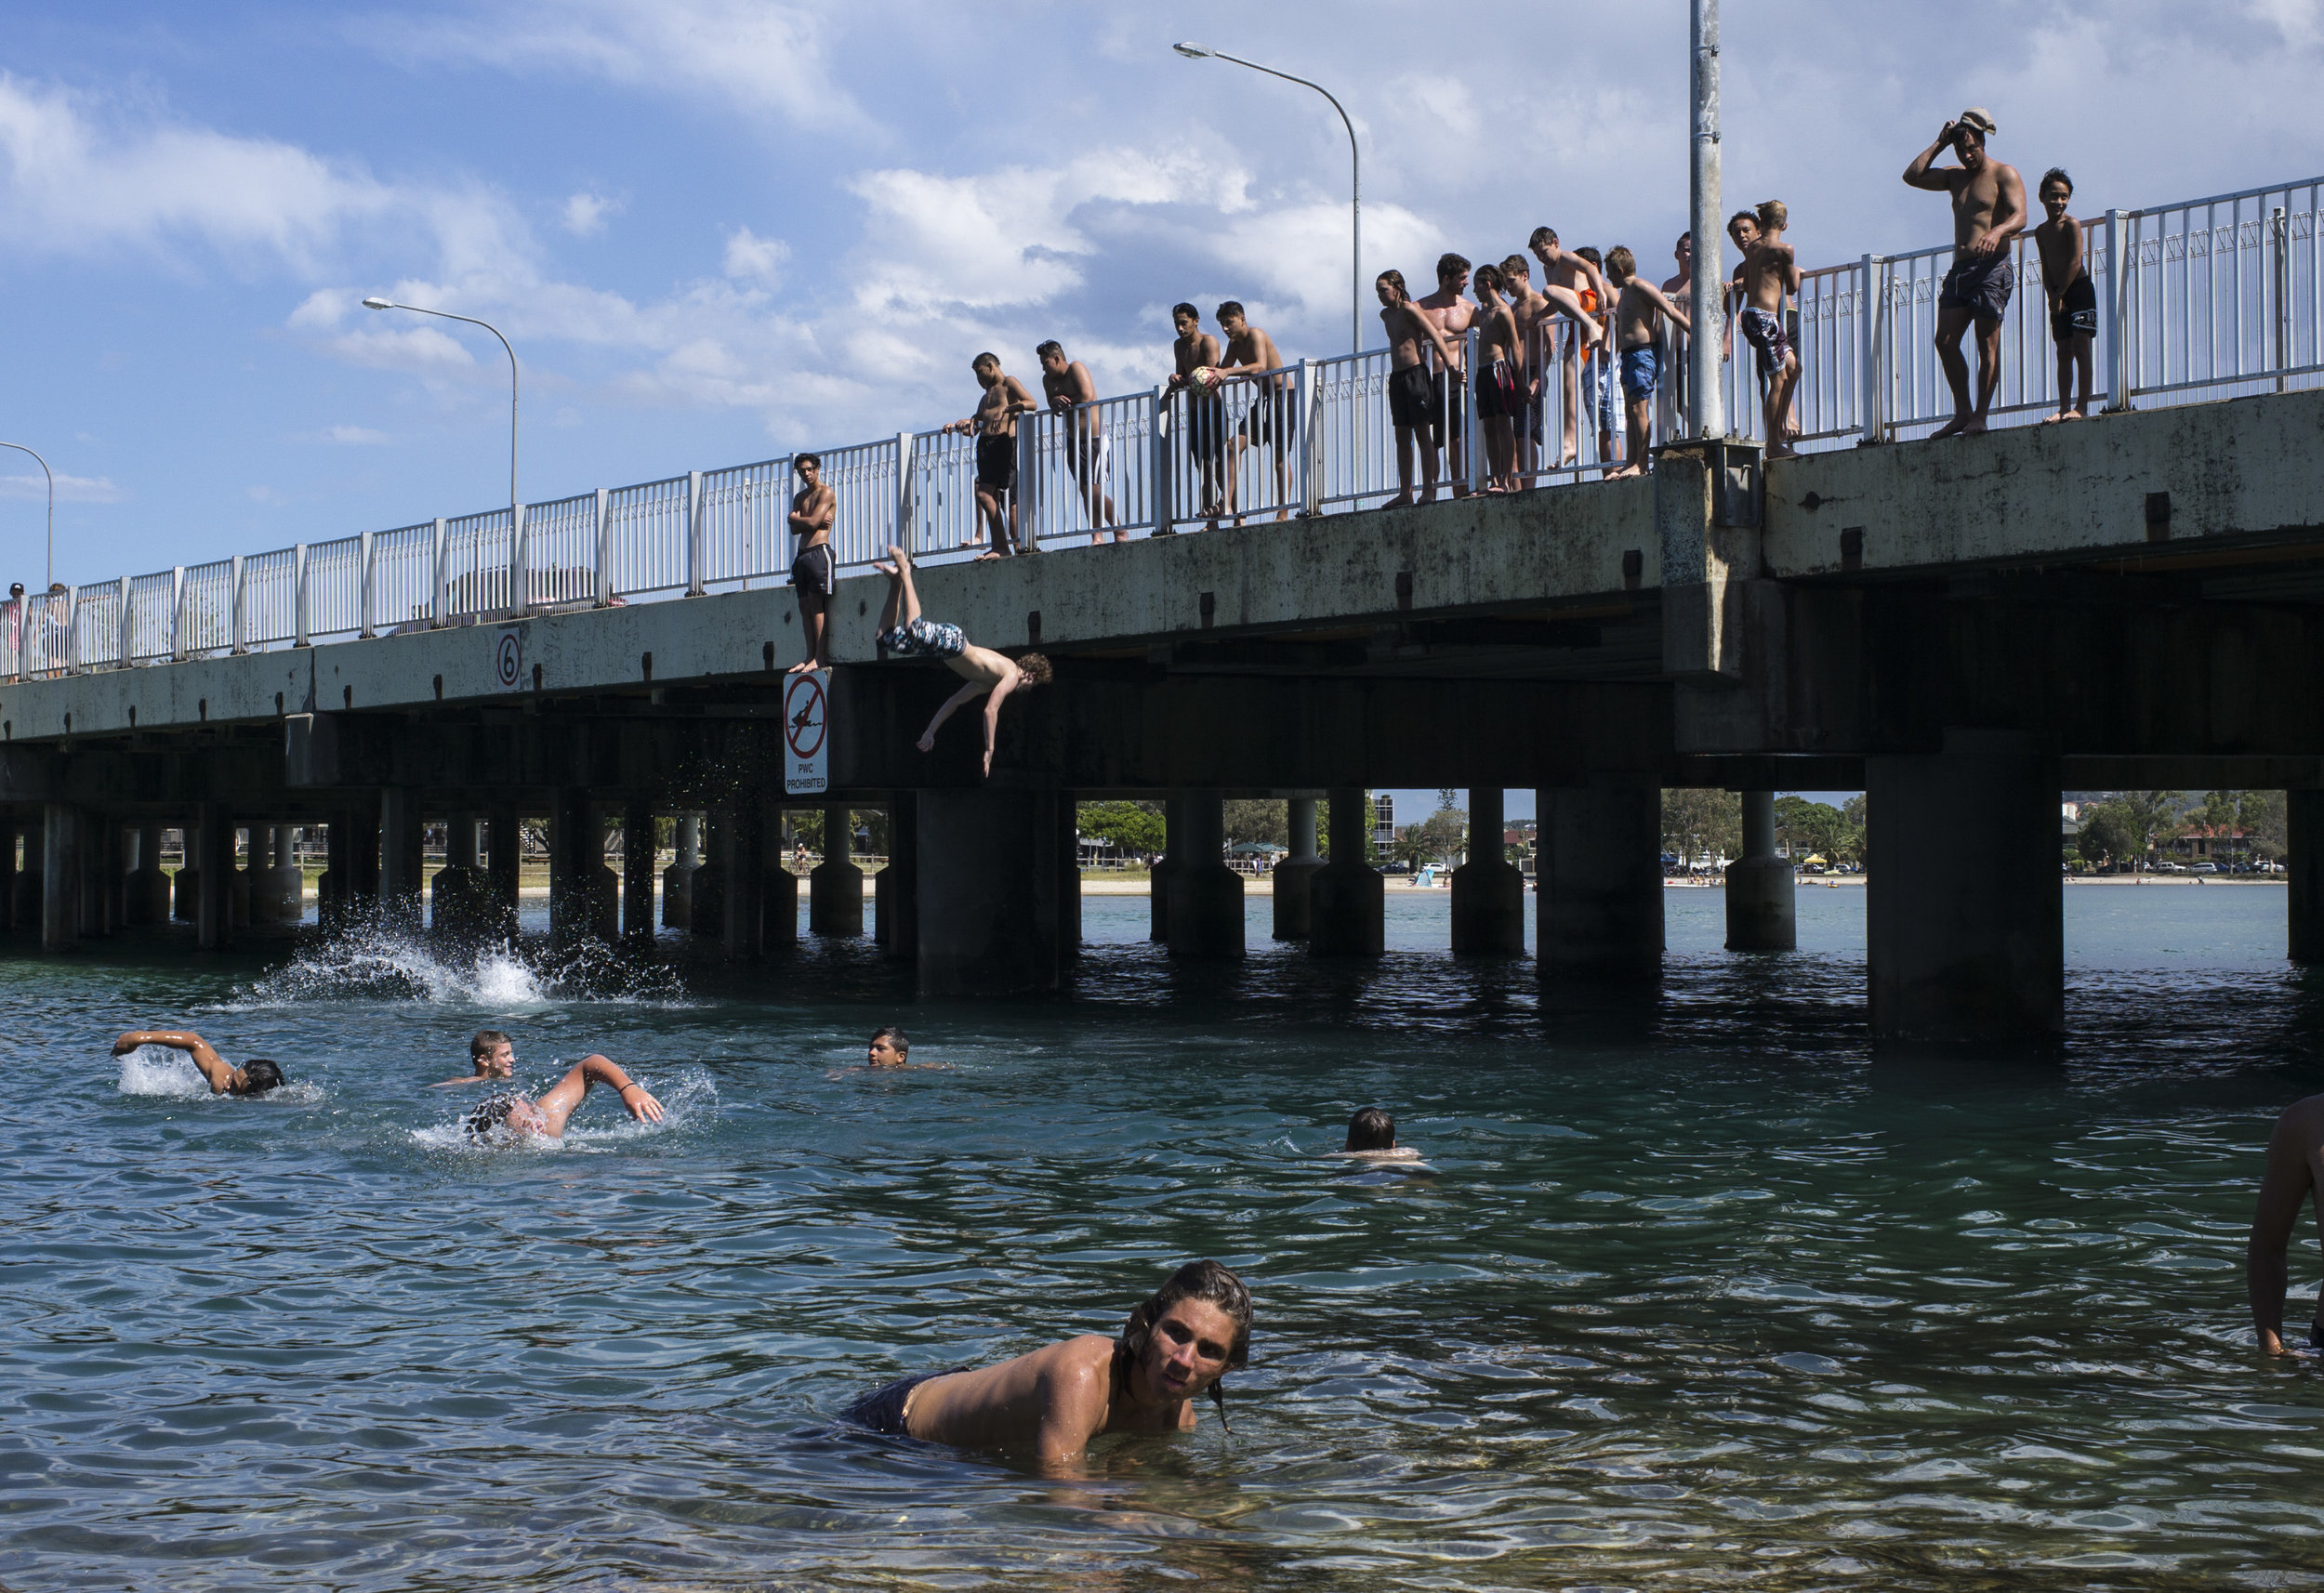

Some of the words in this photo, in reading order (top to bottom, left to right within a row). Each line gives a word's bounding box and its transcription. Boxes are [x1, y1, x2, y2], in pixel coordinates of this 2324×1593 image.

[504, 641, 515, 678] 6
[798, 763, 813, 773] PWC
[786, 777, 825, 789] PROHIBITED
